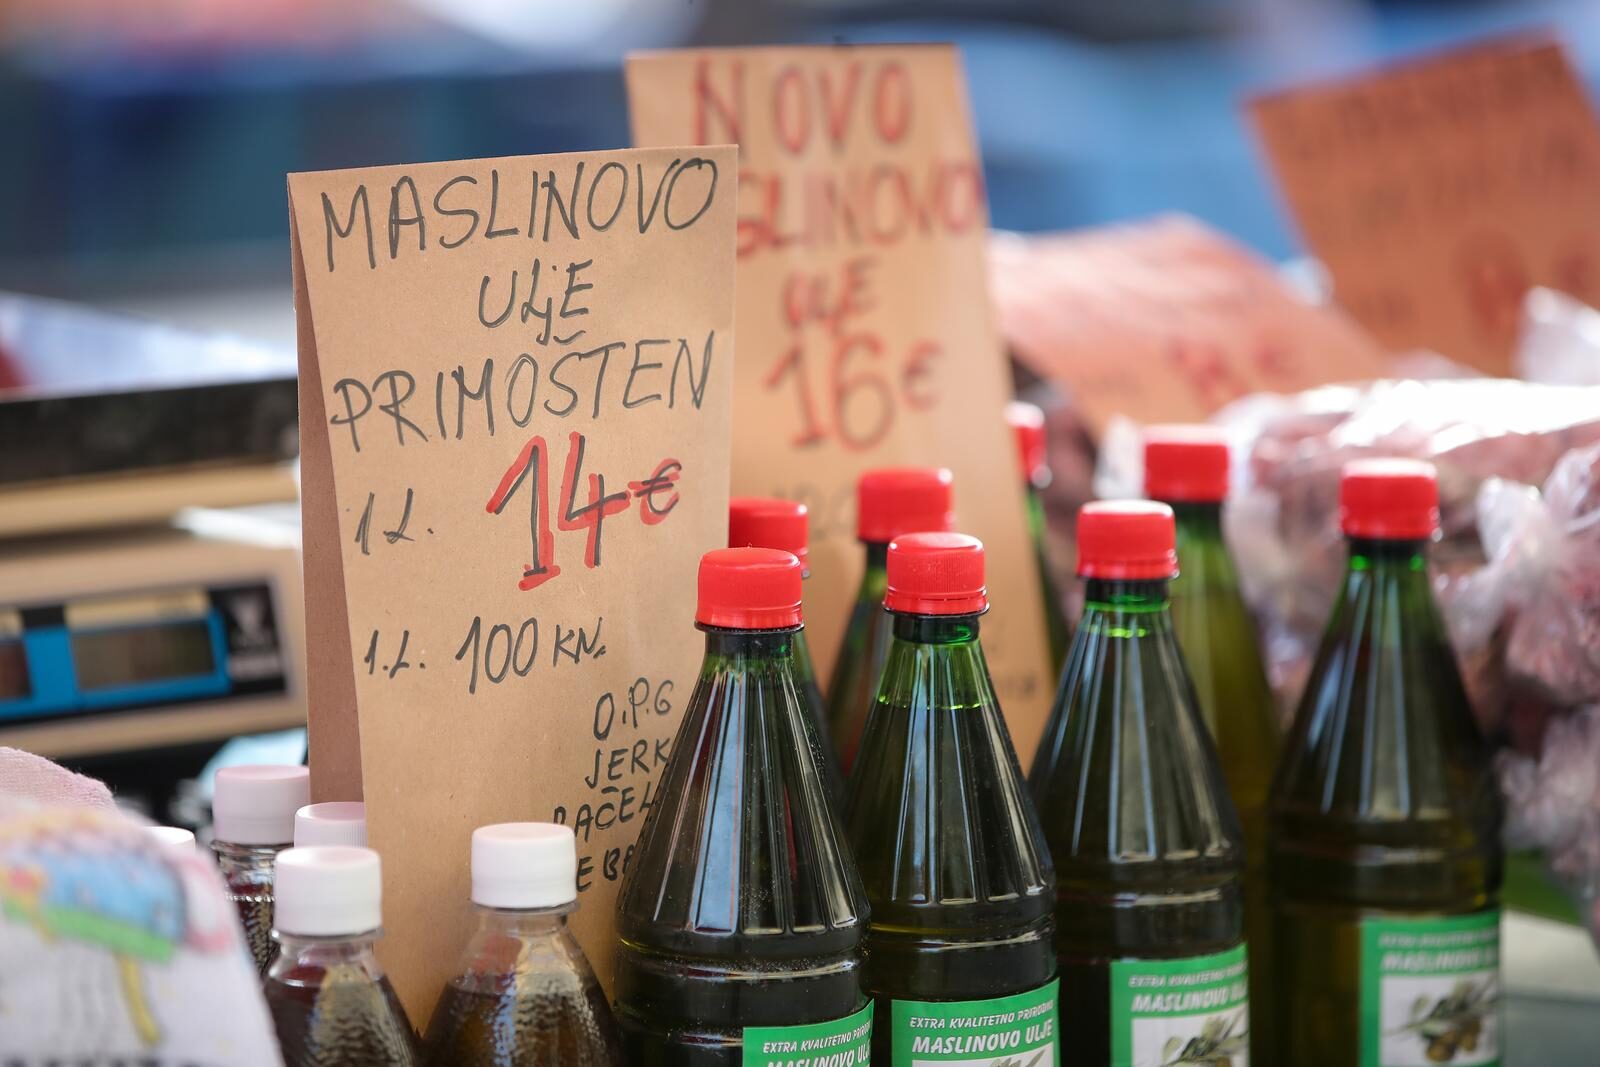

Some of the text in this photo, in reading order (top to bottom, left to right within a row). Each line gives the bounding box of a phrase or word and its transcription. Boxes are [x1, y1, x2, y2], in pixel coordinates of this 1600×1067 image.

[692, 58, 912, 158] NOVO
[321, 157, 718, 272] MASLINOVO
[330, 329, 715, 452] PRIMOŠTEN
[455, 616, 539, 695] 100
[910, 1017, 945, 1029] EXTRA
[949, 1012, 1016, 1029] KVALITETNO
[1131, 987, 1229, 1012] MASLINOVO
[763, 1041, 798, 1054] EXTRA
[800, 1032, 852, 1051] KVALITETNO
[912, 1018, 1054, 1054] MASLINOVO ULJE
